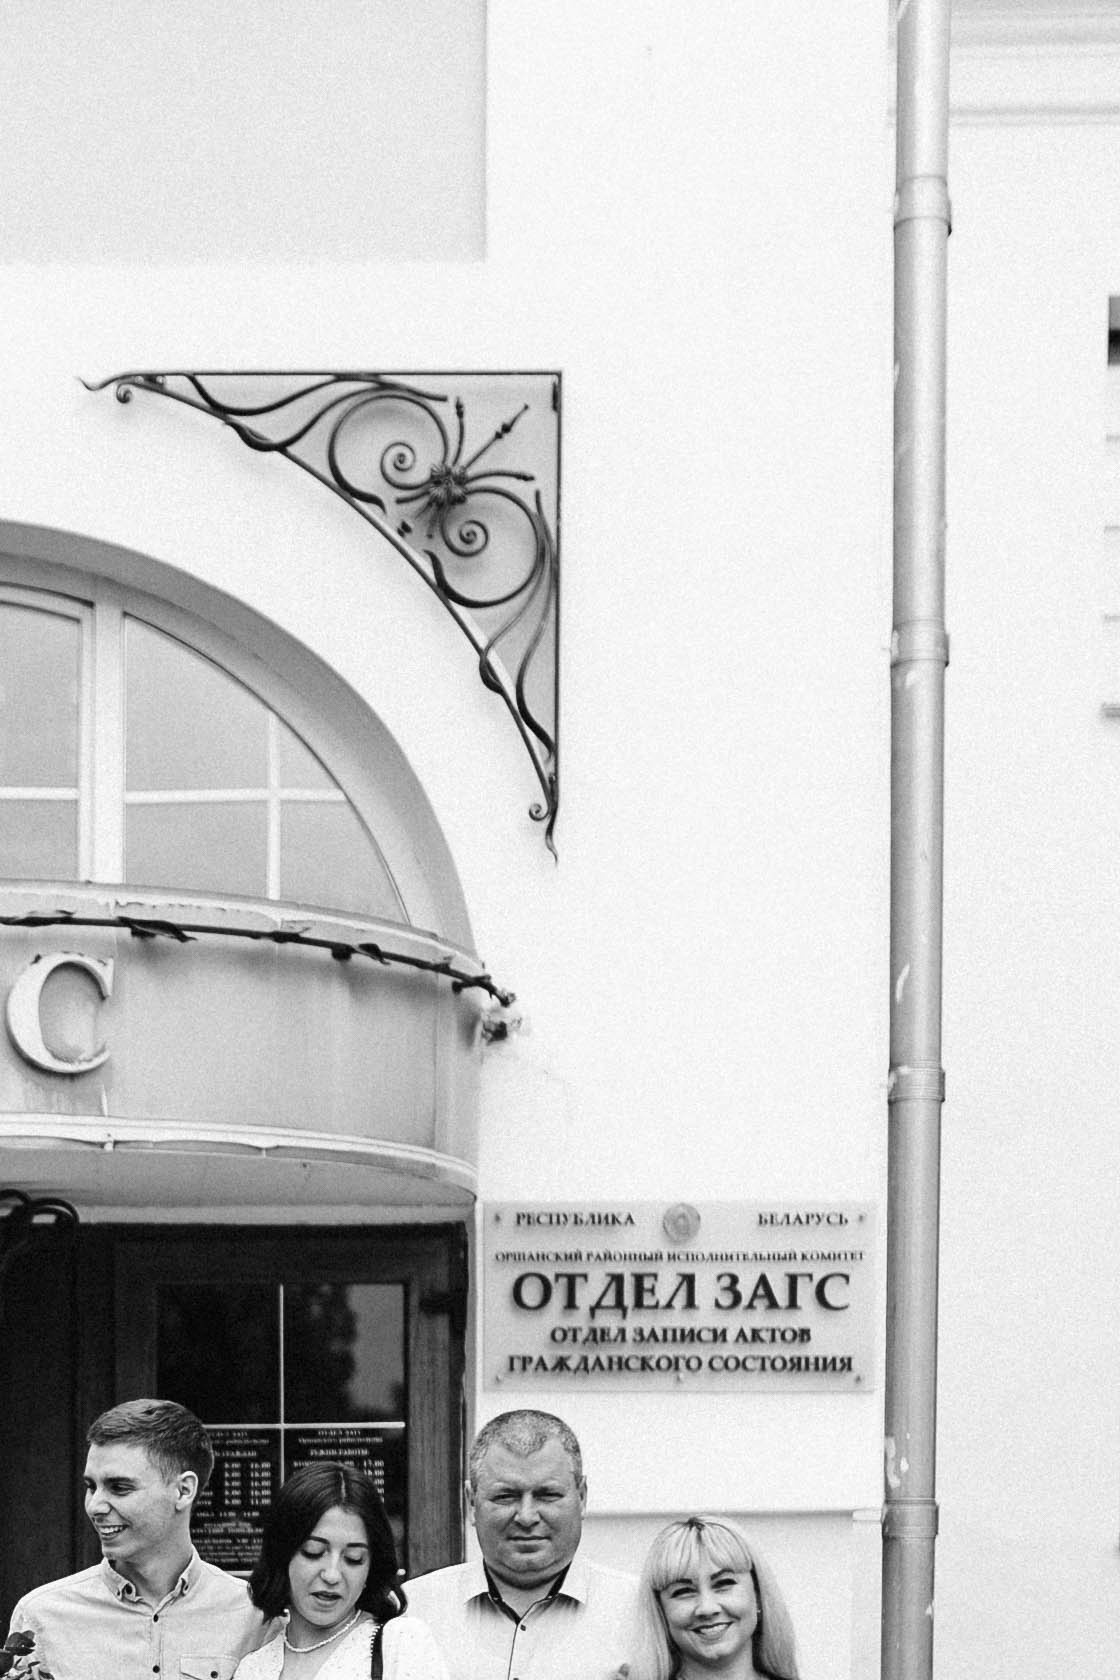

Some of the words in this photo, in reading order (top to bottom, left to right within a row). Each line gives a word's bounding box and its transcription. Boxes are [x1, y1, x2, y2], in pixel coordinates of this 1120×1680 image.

[515, 1212, 635, 1227] РЕСПУБЛИКА
[758, 1212, 849, 1227] БЕЛАРУСЬ
[495, 1249, 582, 1263] ОРШАНСКИЙ
[586, 1249, 664, 1263] РАЙОННЫЙ
[667, 1249, 798, 1263] ИСПОЛНИТЕЛЬНЫЙ
[800, 1251, 863, 1263] КОМИТЕТ
[512, 1272, 697, 1320] ОТДЕЛ
[714, 1272, 850, 1312] ЗАГС
[550, 1326, 627, 1346] ОТДЕЛ
[632, 1327, 728, 1345] ЗАПИСИ
[734, 1327, 812, 1345] АКТОВ
[508, 1355, 703, 1375] ГРАЖДАНСКОГО
[707, 1355, 853, 1374] СОСТОЯНИЯ
